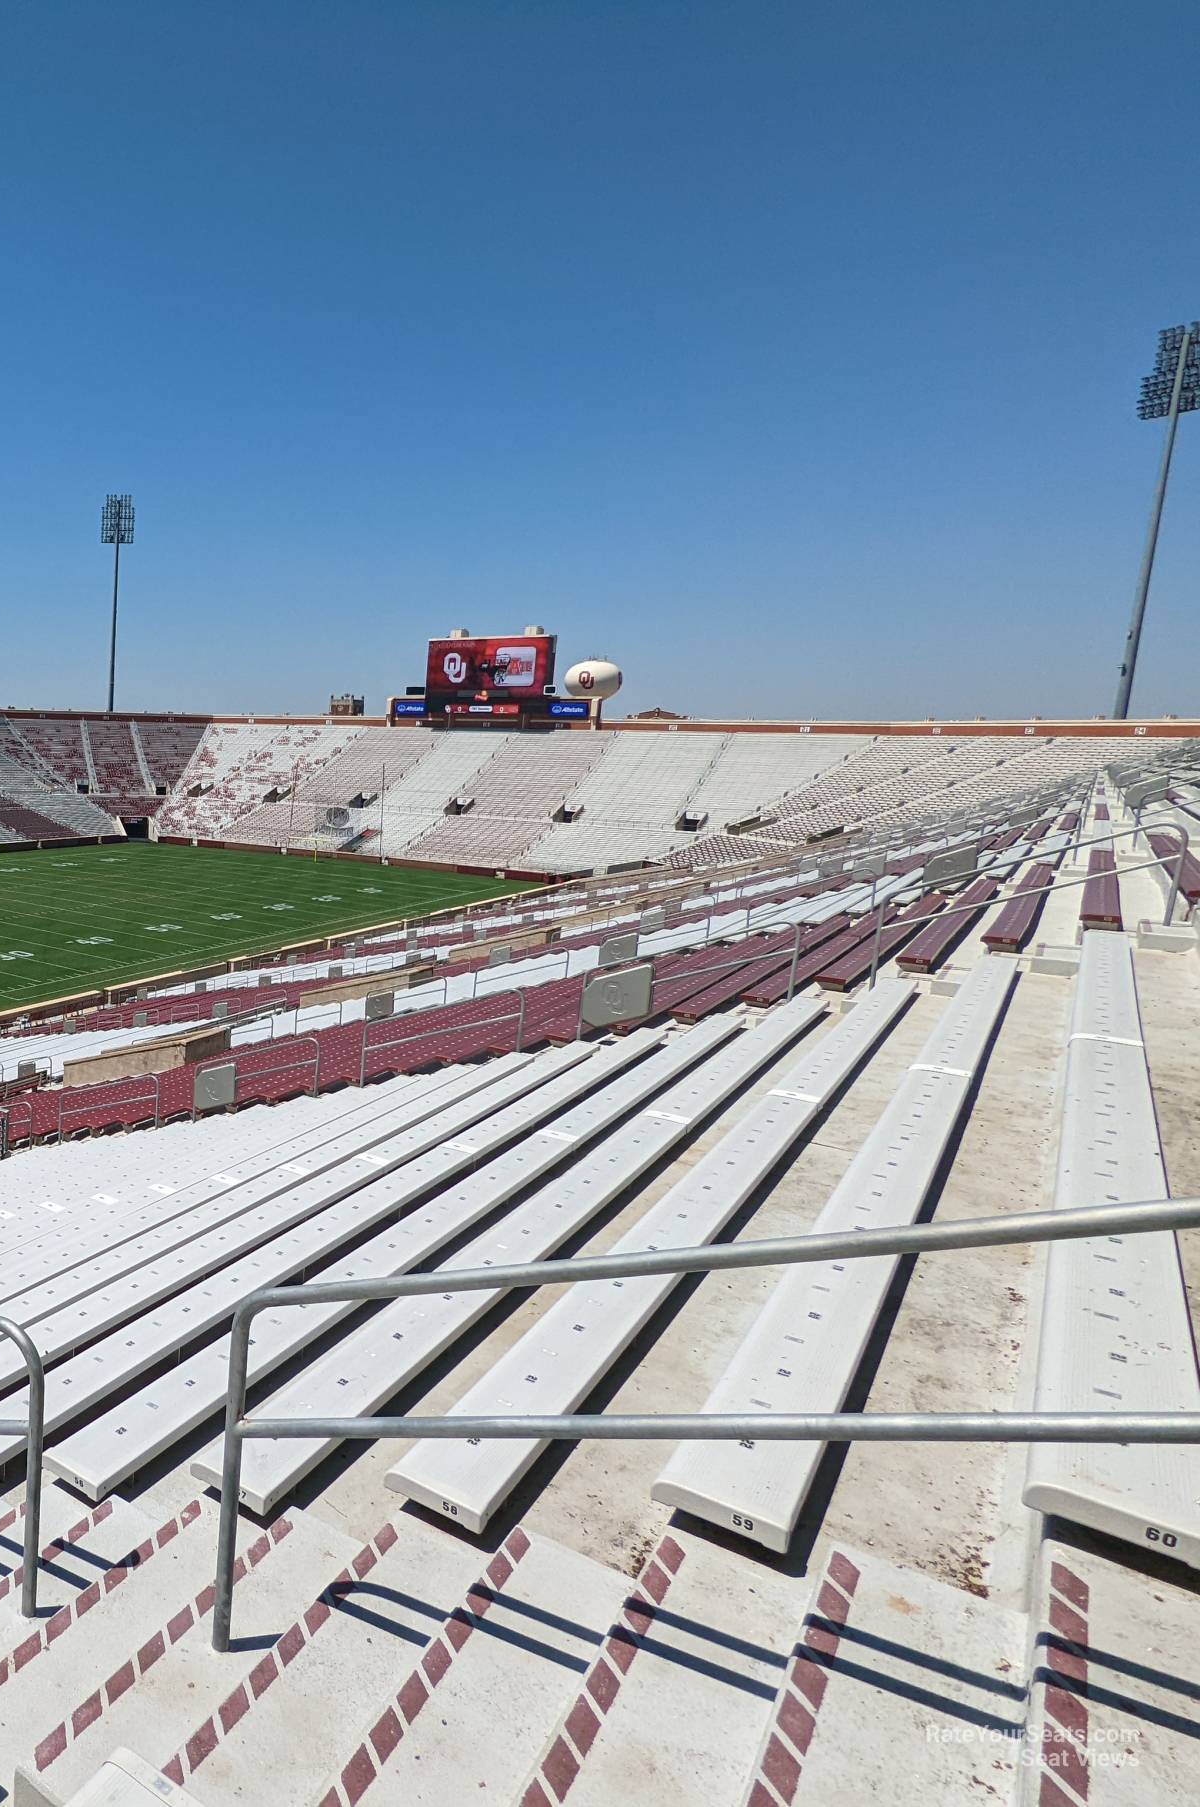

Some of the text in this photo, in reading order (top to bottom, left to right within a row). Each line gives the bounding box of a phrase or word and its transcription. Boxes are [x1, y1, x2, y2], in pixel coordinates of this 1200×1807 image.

[443, 652, 466, 684] OU
[578, 670, 595, 690] OU
[144, 924, 183, 932] 50
[442, 1500, 458, 1516] 58
[731, 1513, 755, 1532] 59
[1145, 1526, 1178, 1548] 60
